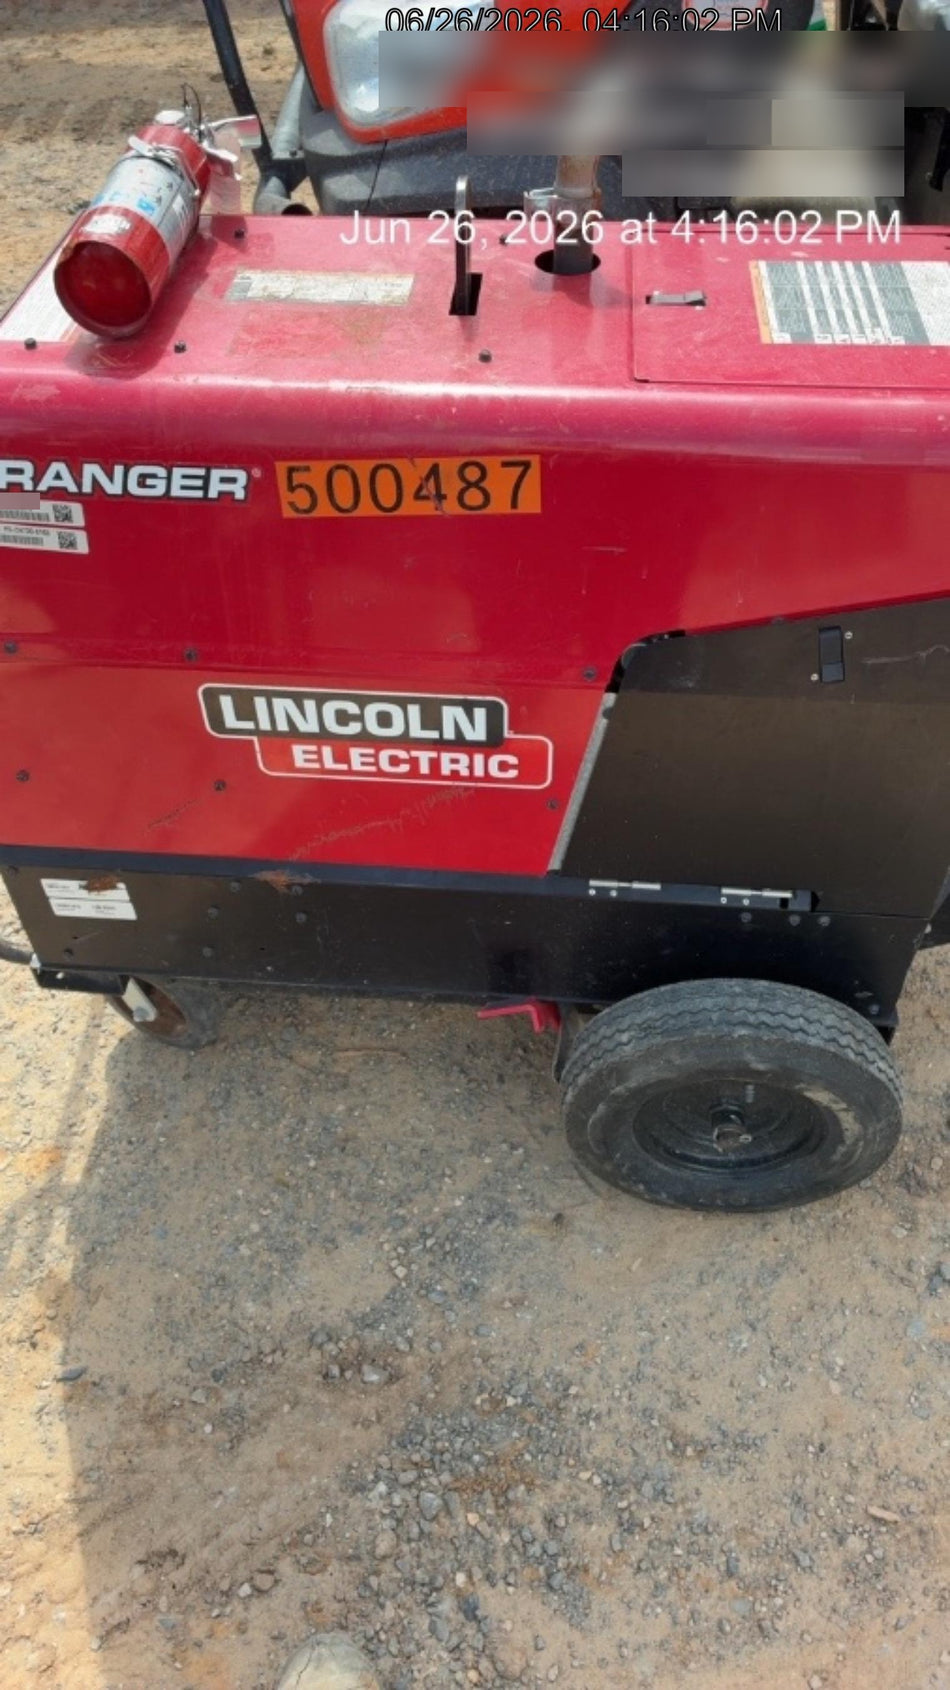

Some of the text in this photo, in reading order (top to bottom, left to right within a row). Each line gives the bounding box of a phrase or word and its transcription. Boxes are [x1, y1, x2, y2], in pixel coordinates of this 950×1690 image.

[285, 460, 534, 515] 500487
[218, 695, 488, 742] LINCOLN
[290, 744, 520, 778] ELECTRIC
